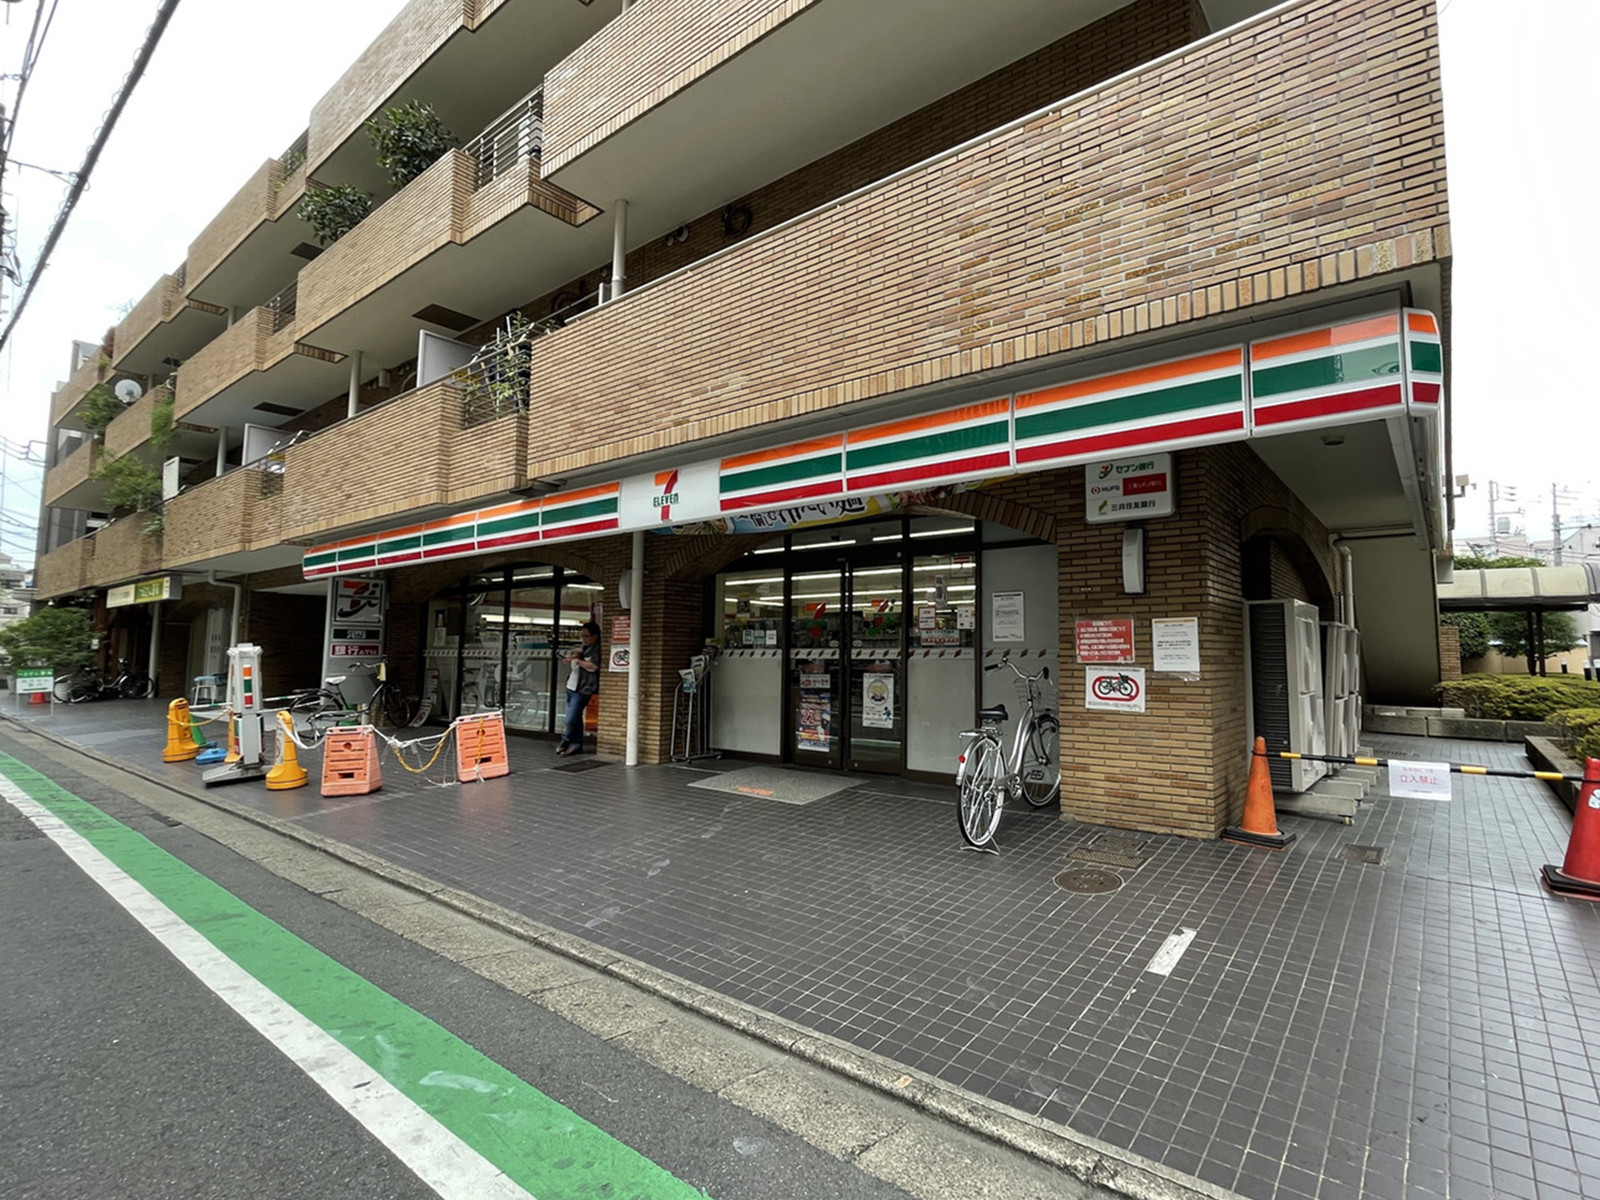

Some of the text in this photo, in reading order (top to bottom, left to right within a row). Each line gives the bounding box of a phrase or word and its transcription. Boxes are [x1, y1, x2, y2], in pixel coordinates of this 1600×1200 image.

[1116, 461, 1155, 474] セブン銀行
[1111, 500, 1156, 512] 三井住友銀行
